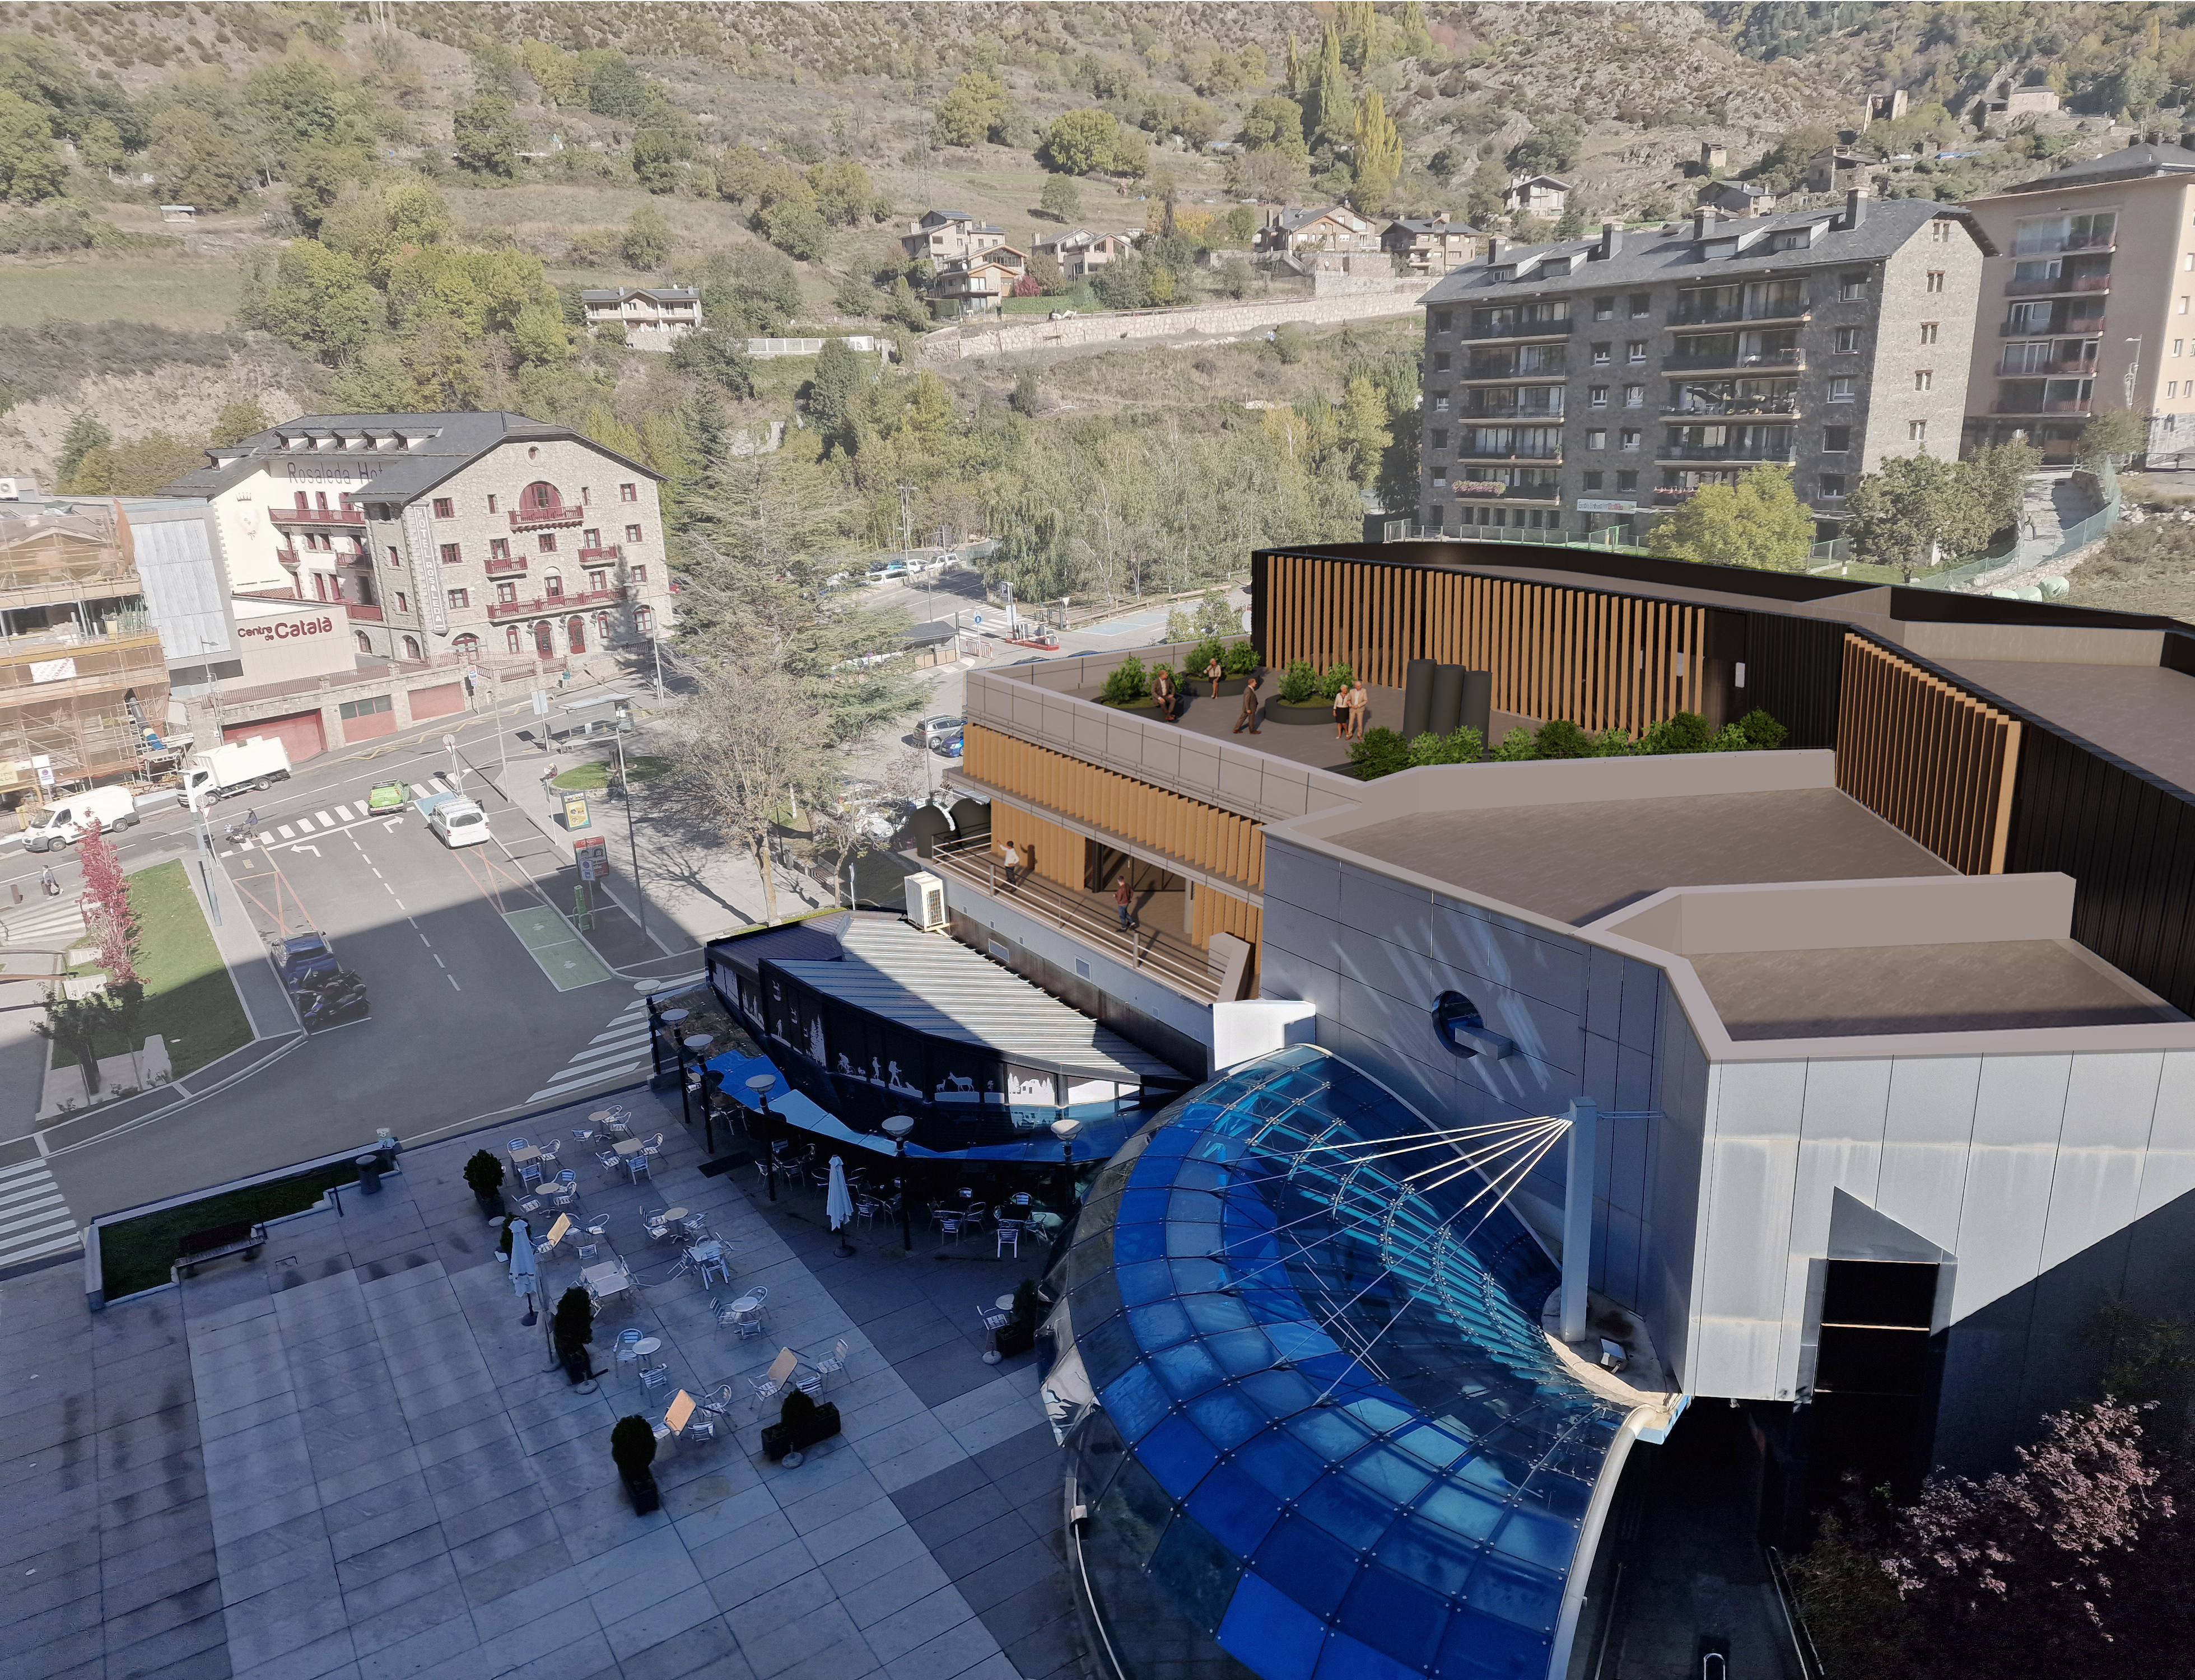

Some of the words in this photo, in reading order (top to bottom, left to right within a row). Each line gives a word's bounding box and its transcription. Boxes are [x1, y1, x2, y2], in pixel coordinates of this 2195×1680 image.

[287, 462, 351, 484] Rosaleda
[417, 508, 431, 558] HOTEL
[426, 561, 442, 622] ROSALEDA
[237, 626, 272, 637] Centre
[275, 617, 332, 639] Català
